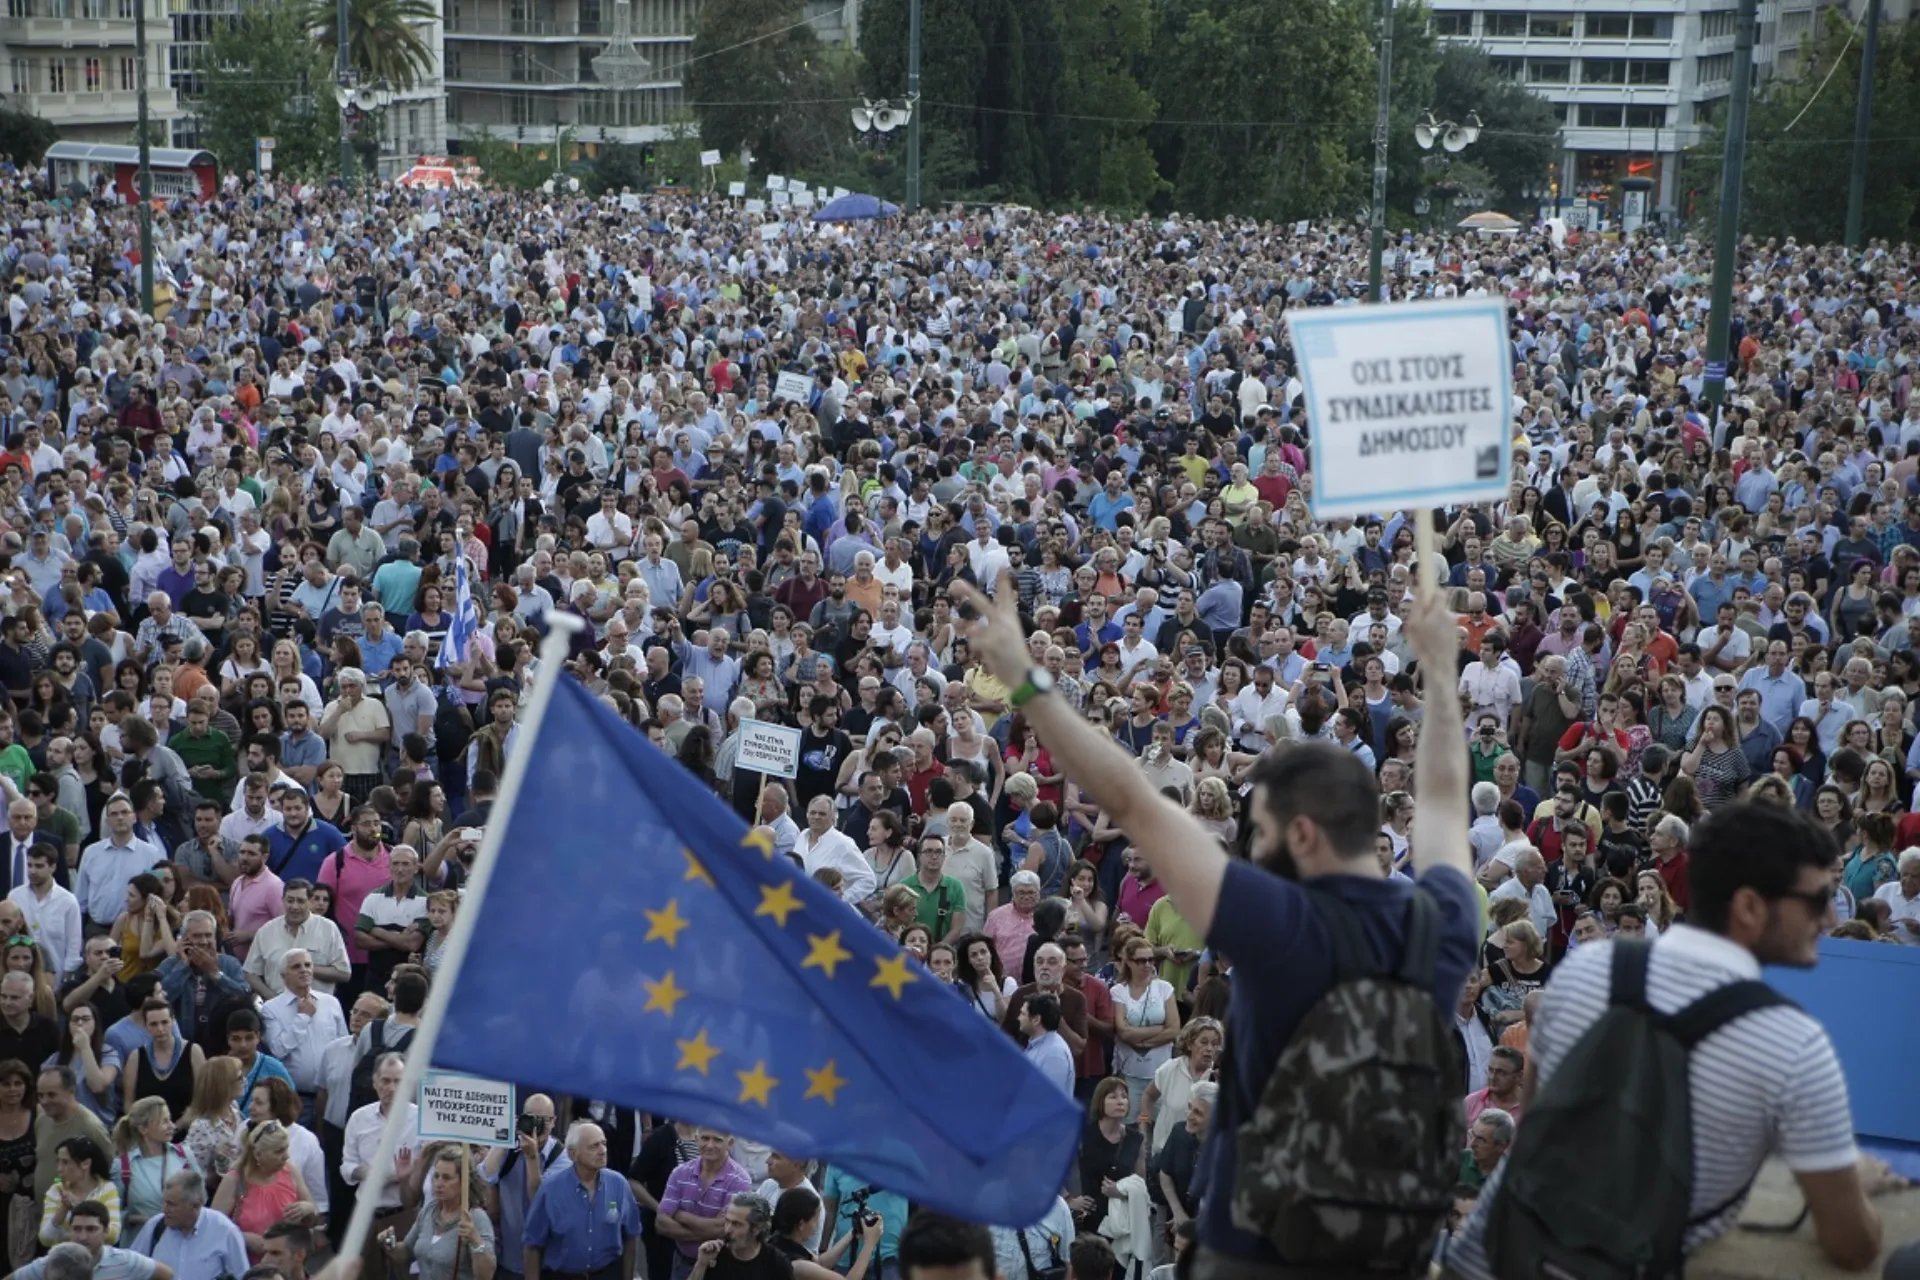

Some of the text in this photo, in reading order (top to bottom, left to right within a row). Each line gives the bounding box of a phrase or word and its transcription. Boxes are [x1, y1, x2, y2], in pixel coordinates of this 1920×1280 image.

[1351, 354, 1465, 386] ΟΧΙ ΣΤΟΥΣ
[1328, 387, 1493, 423] ΣΥΝΔΙΚΑΛΙΣΤΕΣ
[1358, 424, 1468, 457] ΔΗΜΟΣΙΟΥ
[424, 1086, 508, 1105] ΝΑΙ ΣΤΙΣ ΔΙΕΘΝΕΙΣ
[427, 1099, 504, 1116] ΥΠΟΧΡΕΩΣΕΙΣ
[436, 1111, 496, 1128] ΤΗΣ ΧΩΡΑΣ
